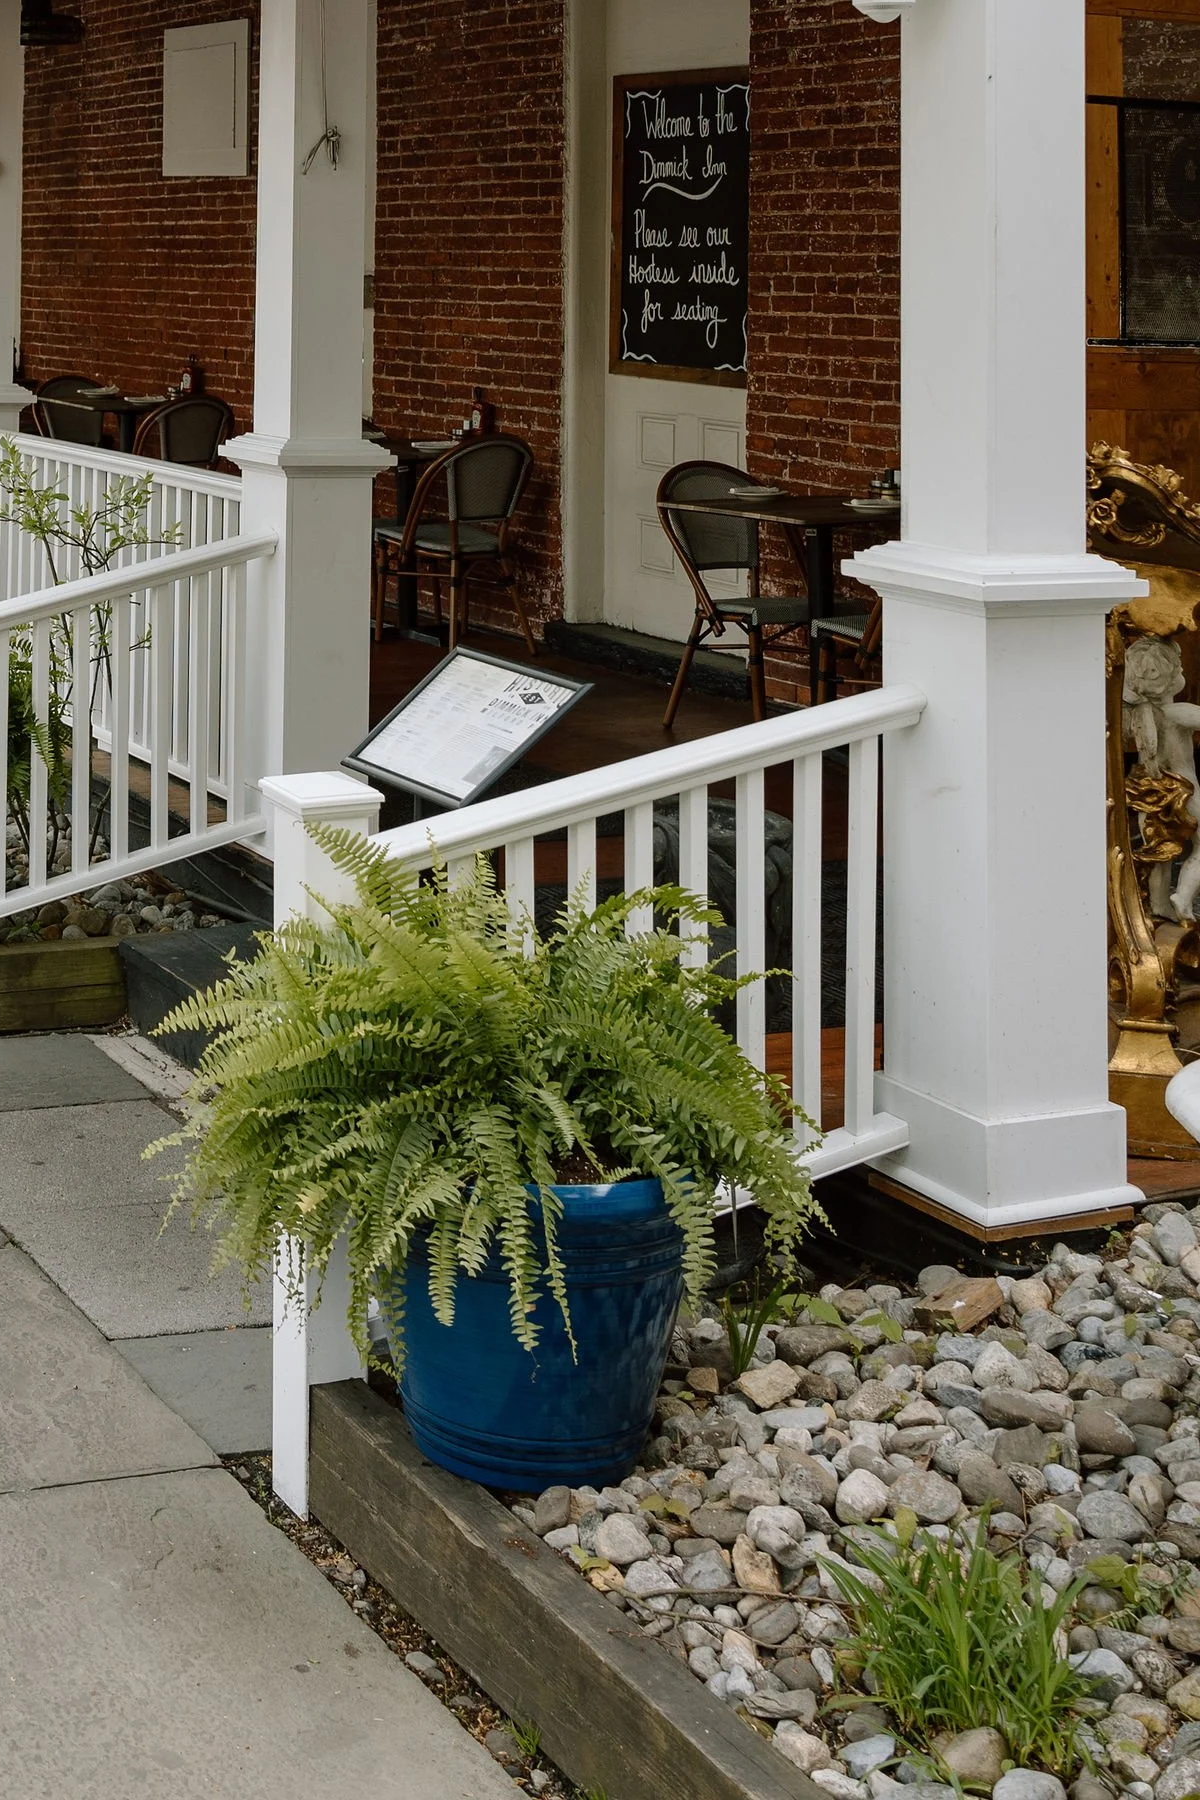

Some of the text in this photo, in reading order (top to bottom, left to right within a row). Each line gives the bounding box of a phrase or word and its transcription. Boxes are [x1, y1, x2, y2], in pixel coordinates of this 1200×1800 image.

[642, 92, 738, 139] Welcome to the
[639, 144, 728, 185] Dimmick Inn
[633, 208, 732, 249] Please see our
[629, 251, 740, 287] Hostess inside
[641, 289, 728, 349] for seating
